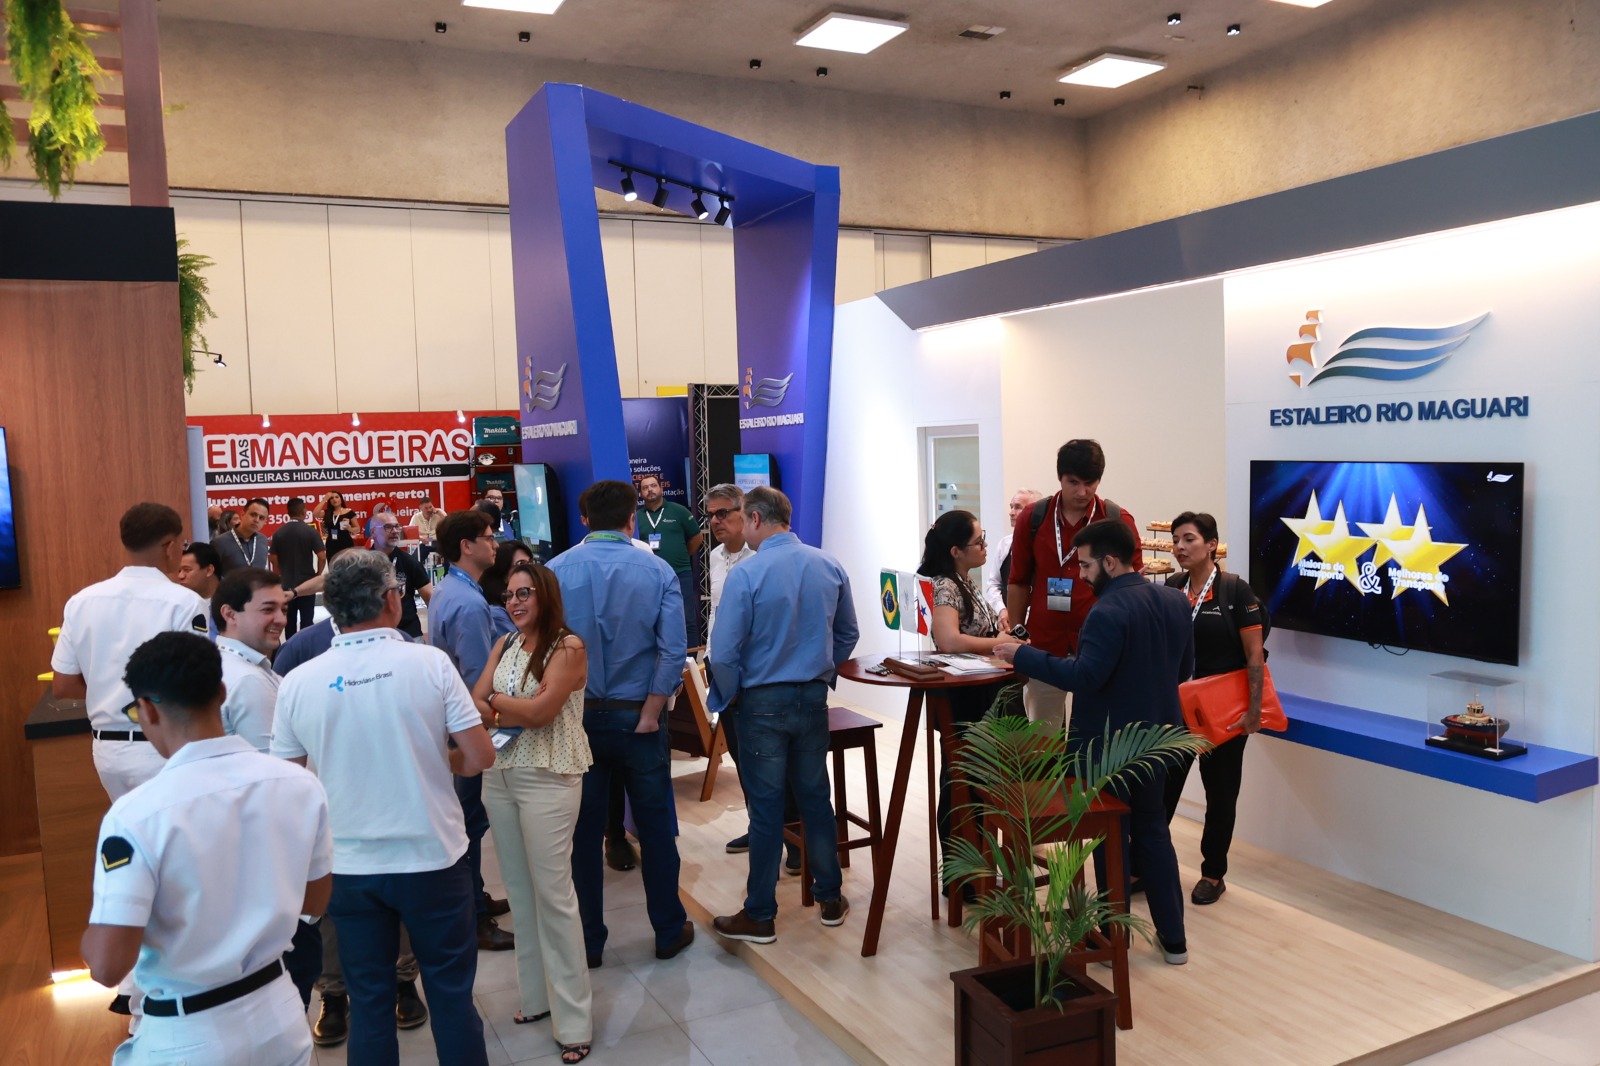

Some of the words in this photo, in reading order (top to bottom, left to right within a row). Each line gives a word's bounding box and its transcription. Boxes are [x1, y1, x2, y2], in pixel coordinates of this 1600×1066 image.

[1270, 403, 1372, 426] ESTALEIRO
[1377, 401, 1413, 422] RIO
[1418, 395, 1530, 421] MAGUARI
[238, 438, 250, 468] DAS
[250, 433, 469, 468] MANGUEIRAS
[215, 472, 290, 483] MANGUEIRAS
[293, 468, 366, 481] HIDRÁULICAS
[368, 469, 375, 478] E
[378, 467, 442, 478] INDUSTRIAIS
[1297, 559, 1332, 571] Maiores
[1333, 561, 1345, 571] do
[1299, 568, 1345, 581] Transporte
[1357, 561, 1382, 594] &
[1388, 567, 1434, 581] Melhores
[376, 670, 393, 680] Brasil
